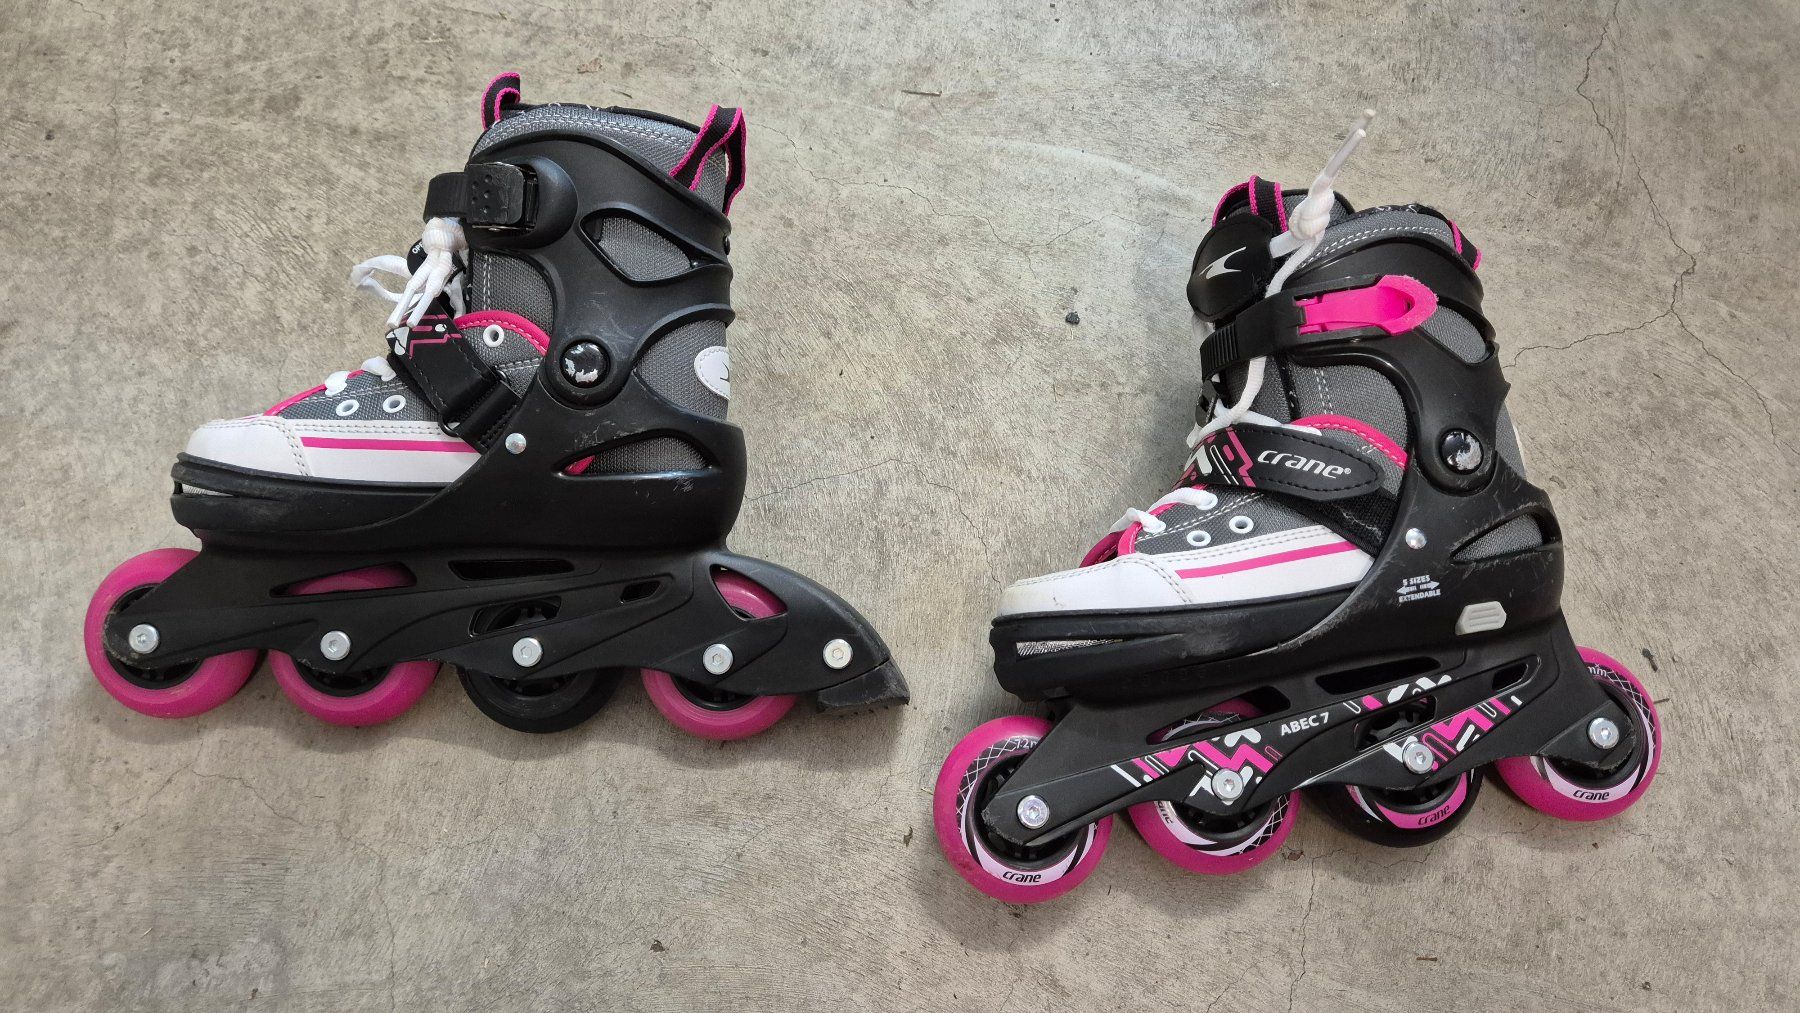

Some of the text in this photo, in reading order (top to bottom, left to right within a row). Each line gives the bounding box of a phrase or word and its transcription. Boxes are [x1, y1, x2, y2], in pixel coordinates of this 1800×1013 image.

[1409, 574, 1431, 585] SIZES
[1398, 588, 1441, 603] EXTENDABLE
[1281, 711, 1329, 737] ABEC 7
[1573, 790, 1610, 801] crane
[1418, 804, 1451, 825] crane
[1002, 871, 1042, 883] crane
